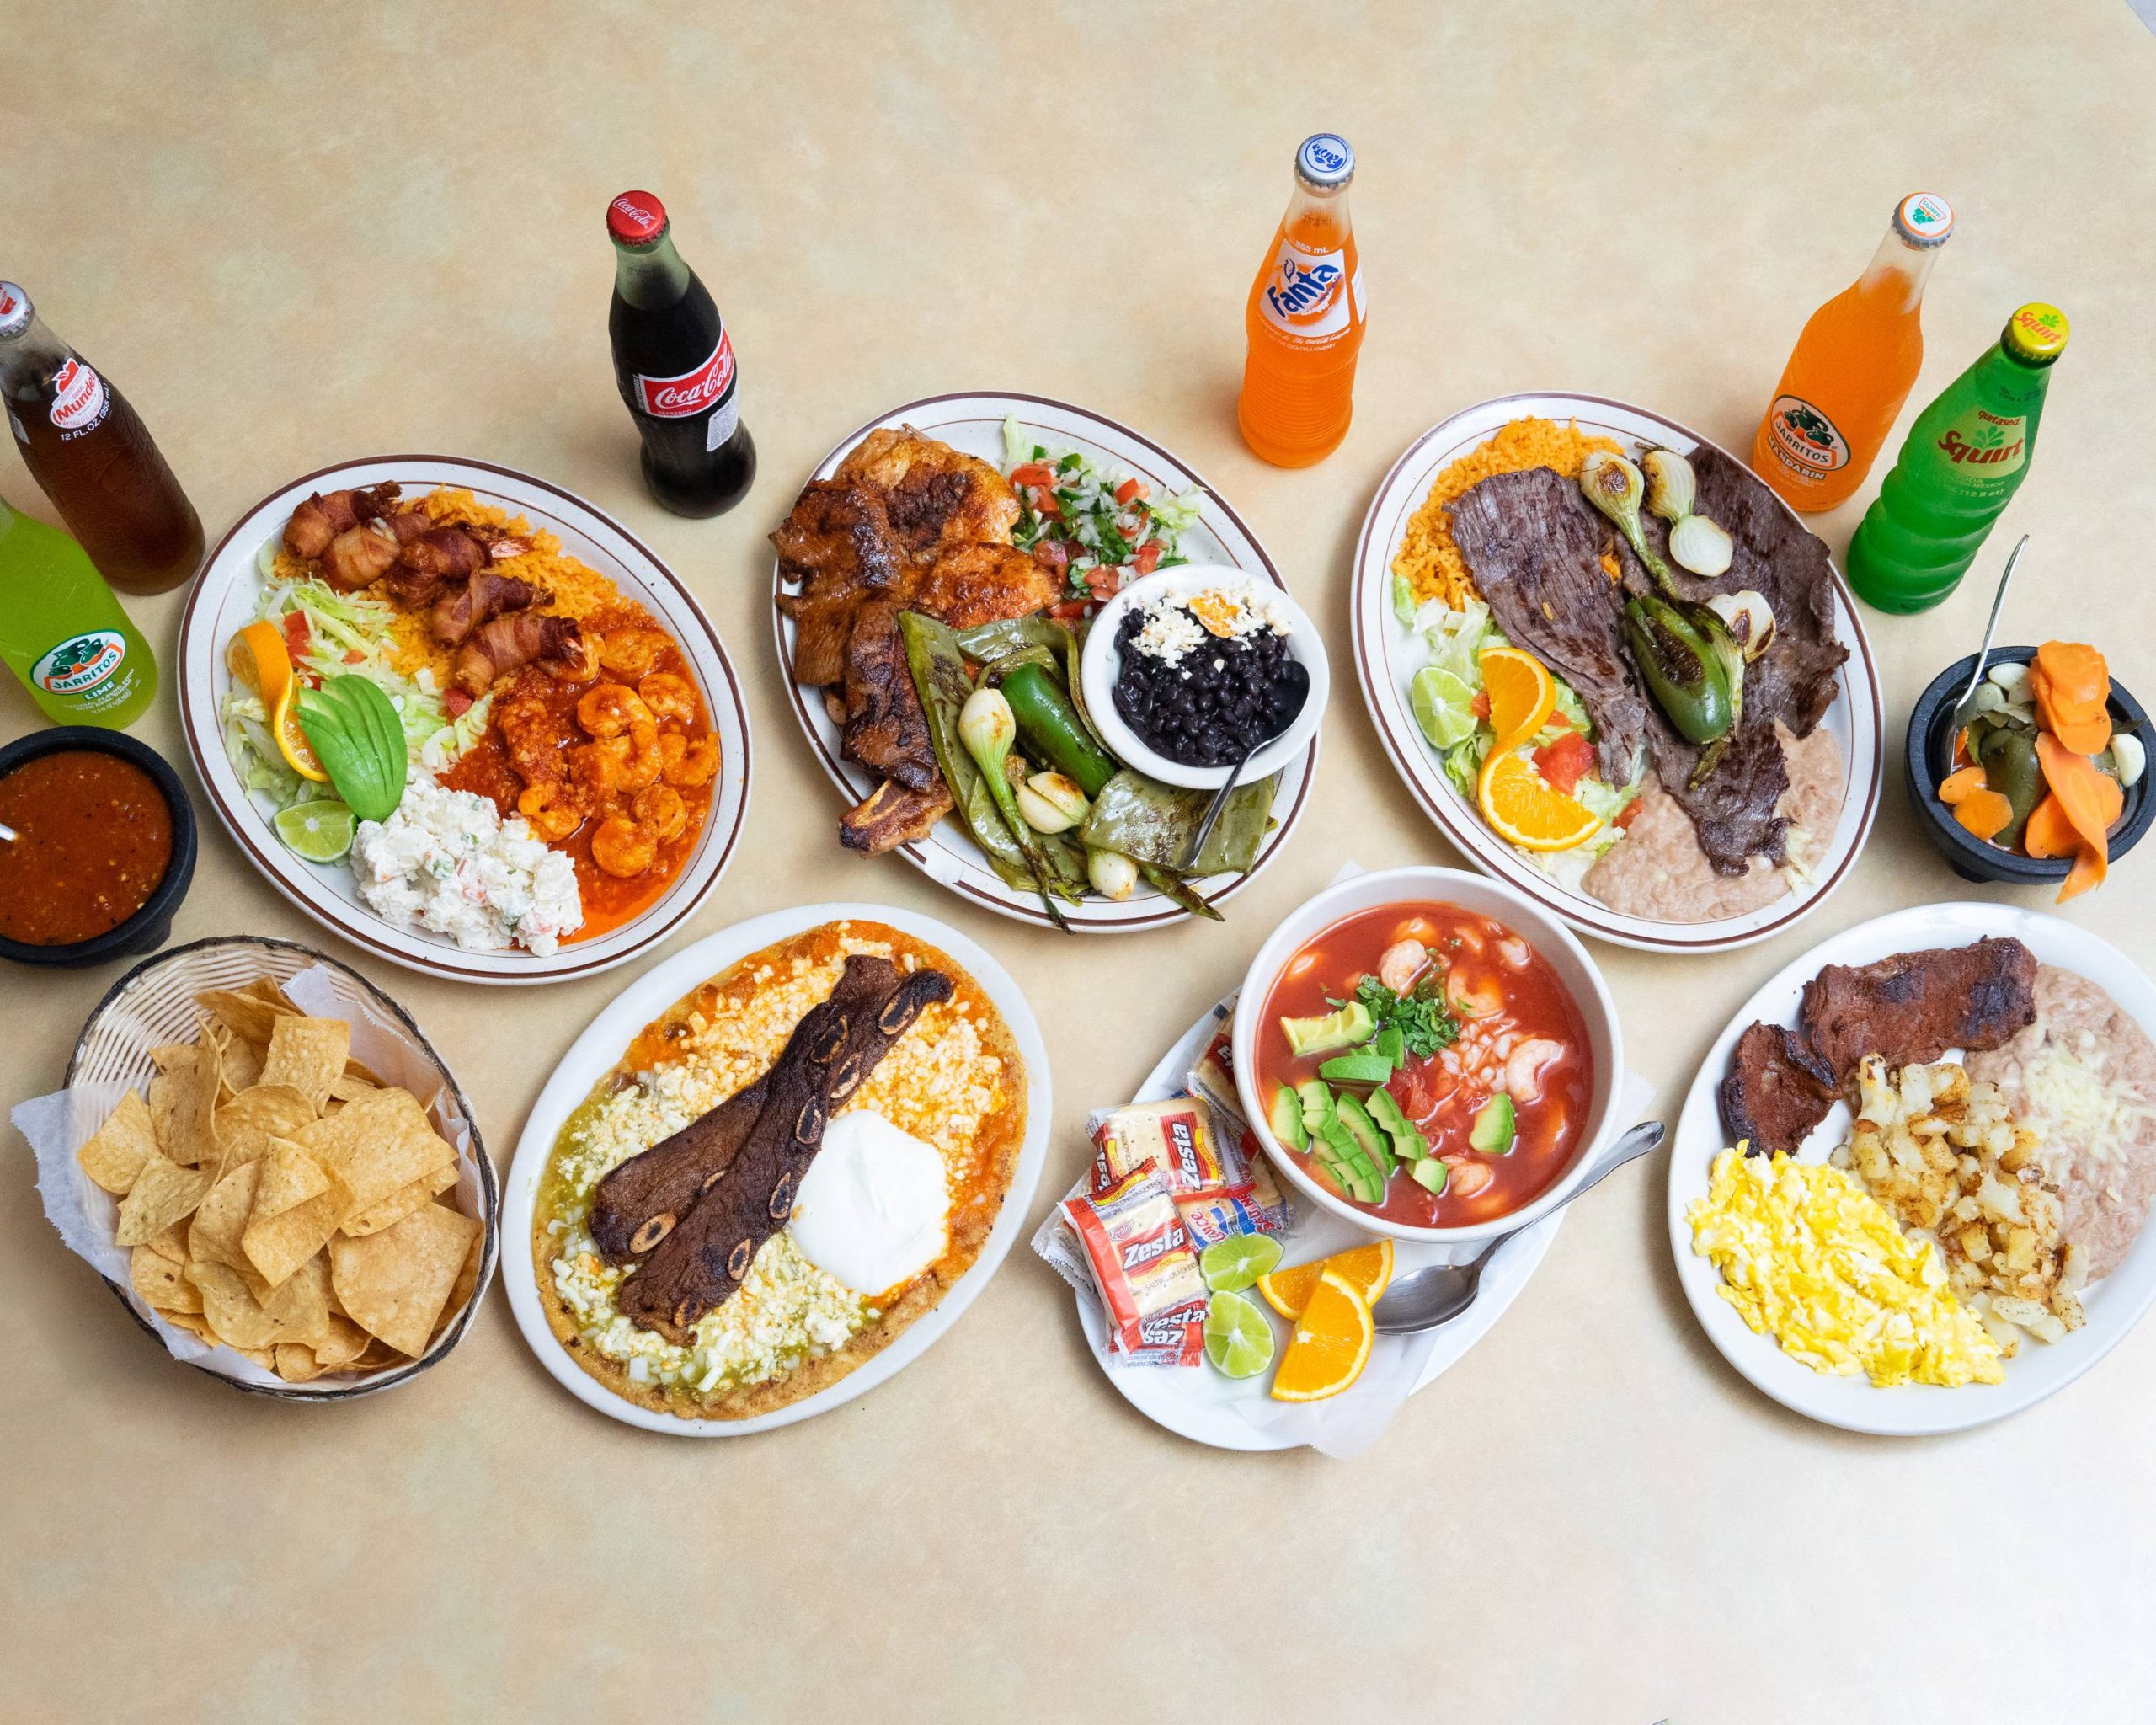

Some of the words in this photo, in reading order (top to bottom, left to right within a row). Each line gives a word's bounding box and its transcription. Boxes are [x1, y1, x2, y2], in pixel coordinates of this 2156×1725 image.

[1312, 144, 1343, 168] Fanta
[612, 198, 656, 226] Coca-Cola
[1267, 264, 1339, 318] Fanta
[2015, 312, 2062, 343] Squirt
[1287, 343, 1312, 352] COCA-COLA
[1314, 342, 1336, 351] COMPANY
[1768, 434, 1826, 480] MANDARIN
[1775, 420, 1829, 463] JARRITOS
[1938, 430, 2024, 463] Squirt
[53, 651, 116, 689] JARRITOS
[84, 681, 115, 700] LIME
[1172, 1122, 1203, 1190] Zesta
[1123, 1227, 1185, 1270] Zesta
